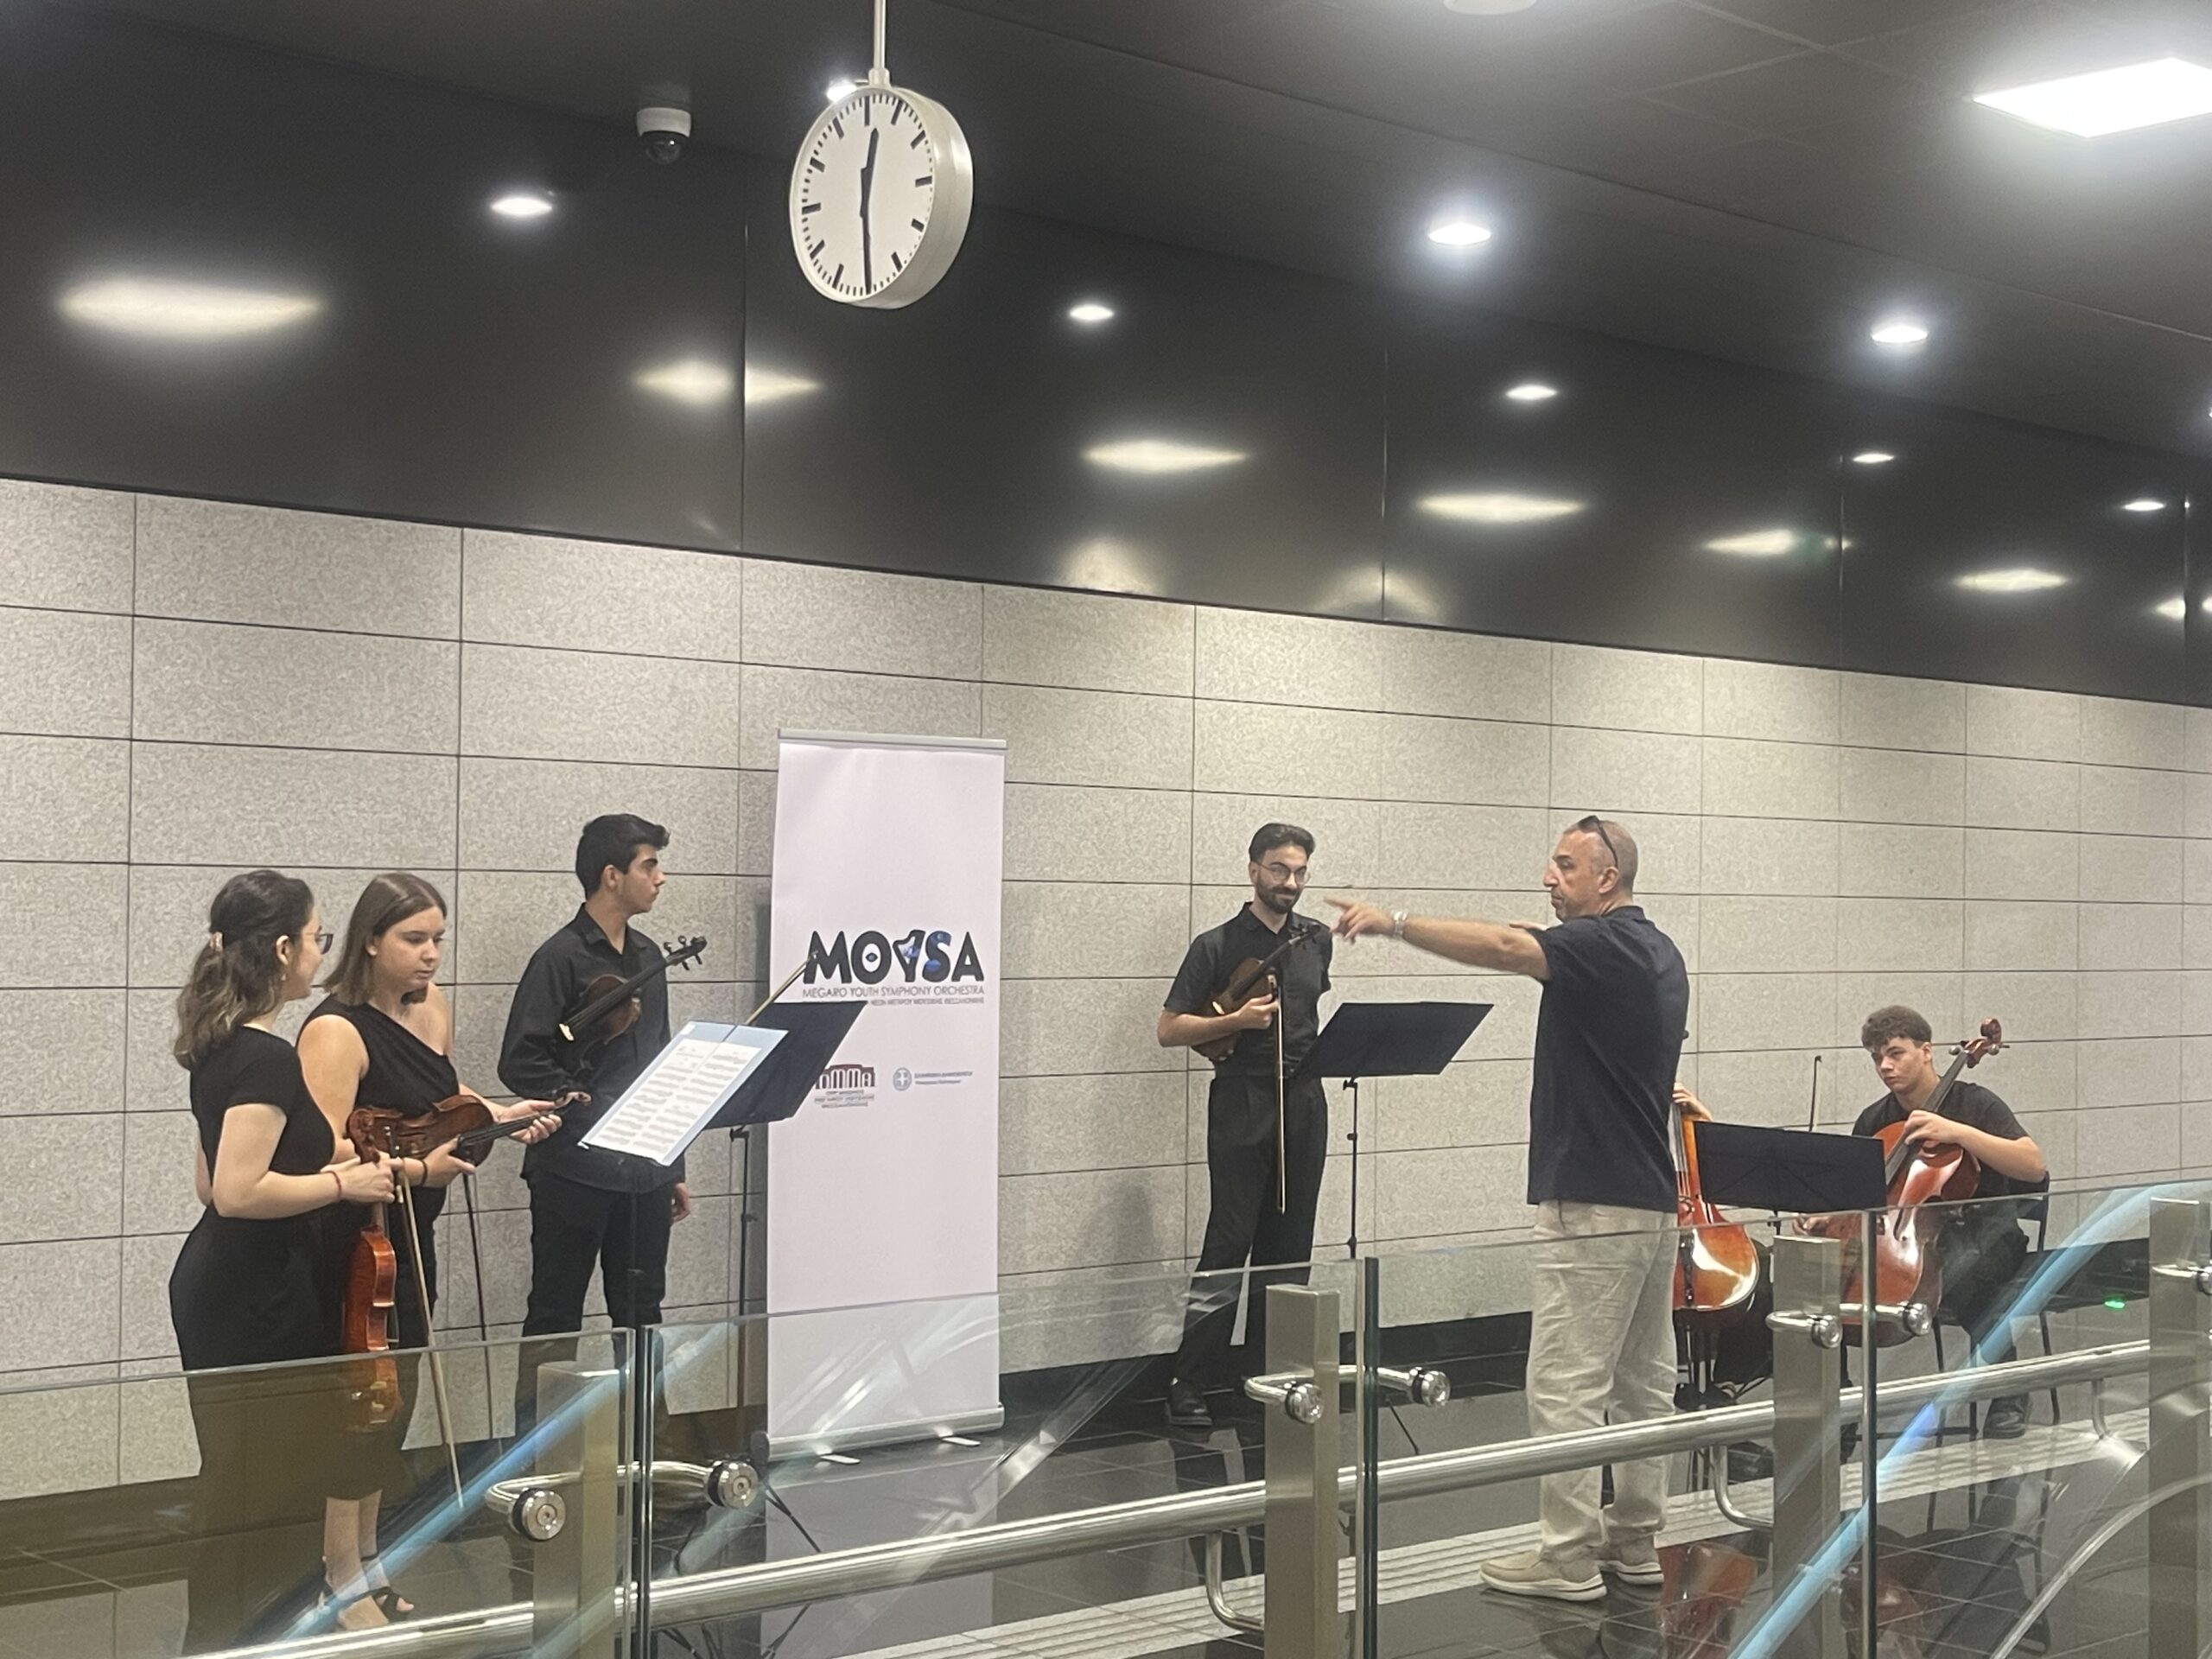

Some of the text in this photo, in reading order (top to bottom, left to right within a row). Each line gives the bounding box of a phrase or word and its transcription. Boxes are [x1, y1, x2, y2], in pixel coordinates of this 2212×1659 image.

[803, 930, 984, 984] MOYSA
[803, 985, 984, 998] MEGARO YOUTH SYMPHONY ORCHESTRA
